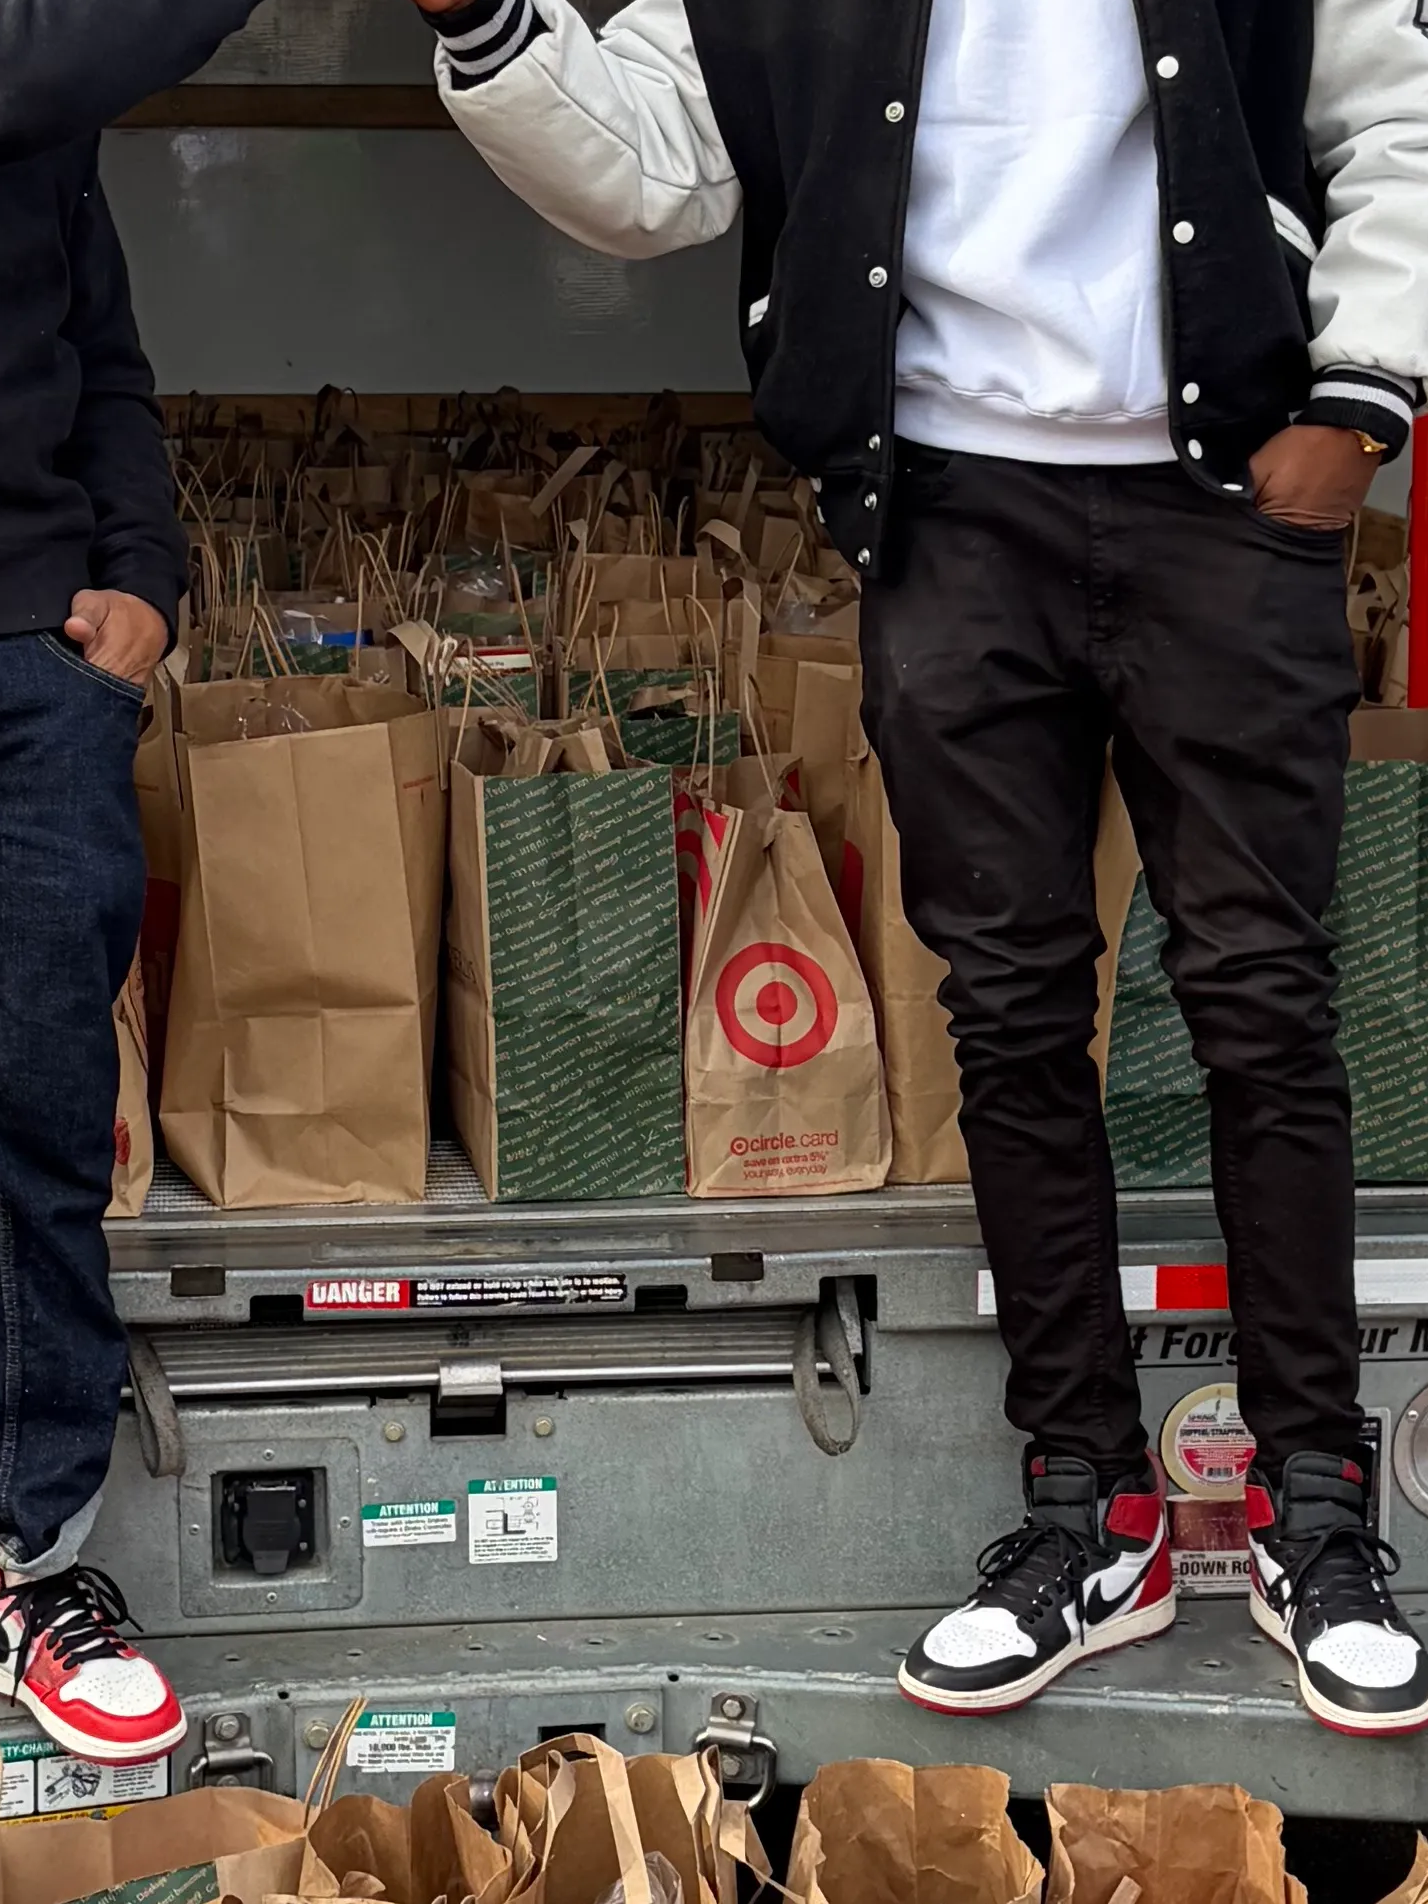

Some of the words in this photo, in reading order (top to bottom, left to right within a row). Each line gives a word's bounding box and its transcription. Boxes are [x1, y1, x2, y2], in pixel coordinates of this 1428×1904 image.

[751, 1133, 795, 1152] circle
[800, 1130, 838, 1146] card
[1160, 1323, 1241, 1366] Forg
[380, 1503, 439, 1517] ATTENTION
[370, 1714, 432, 1726] ATTENTION
